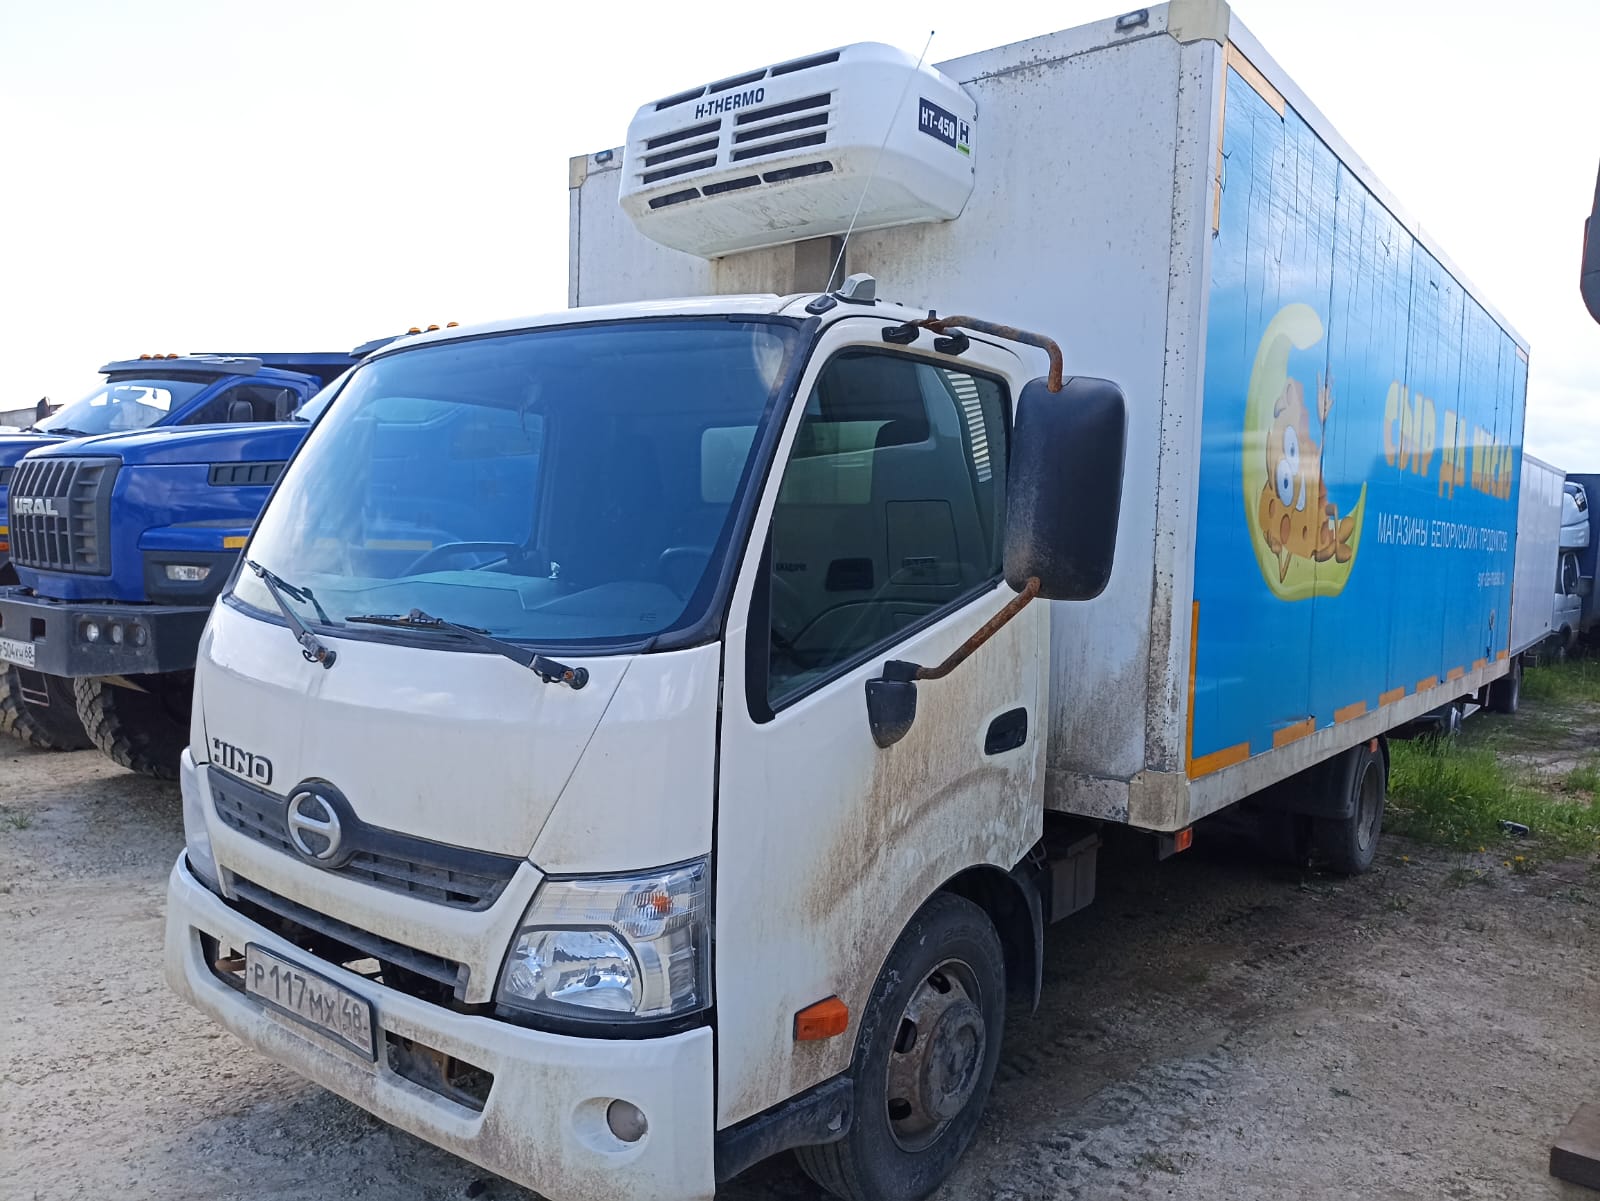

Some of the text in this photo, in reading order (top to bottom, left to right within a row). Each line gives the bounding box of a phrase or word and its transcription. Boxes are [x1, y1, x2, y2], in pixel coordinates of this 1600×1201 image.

[694, 87, 765, 120] H-THERMO
[921, 106, 955, 140] HT-450
[1383, 379, 1436, 478] СЫР
[1438, 409, 1466, 500] ДА
[14, 498, 59, 516] URAL
[1377, 511, 1429, 547] МАГАЗИНЫ
[1431, 519, 1479, 550] БЕЛОРУССКИХ
[212, 737, 273, 785] HINO
